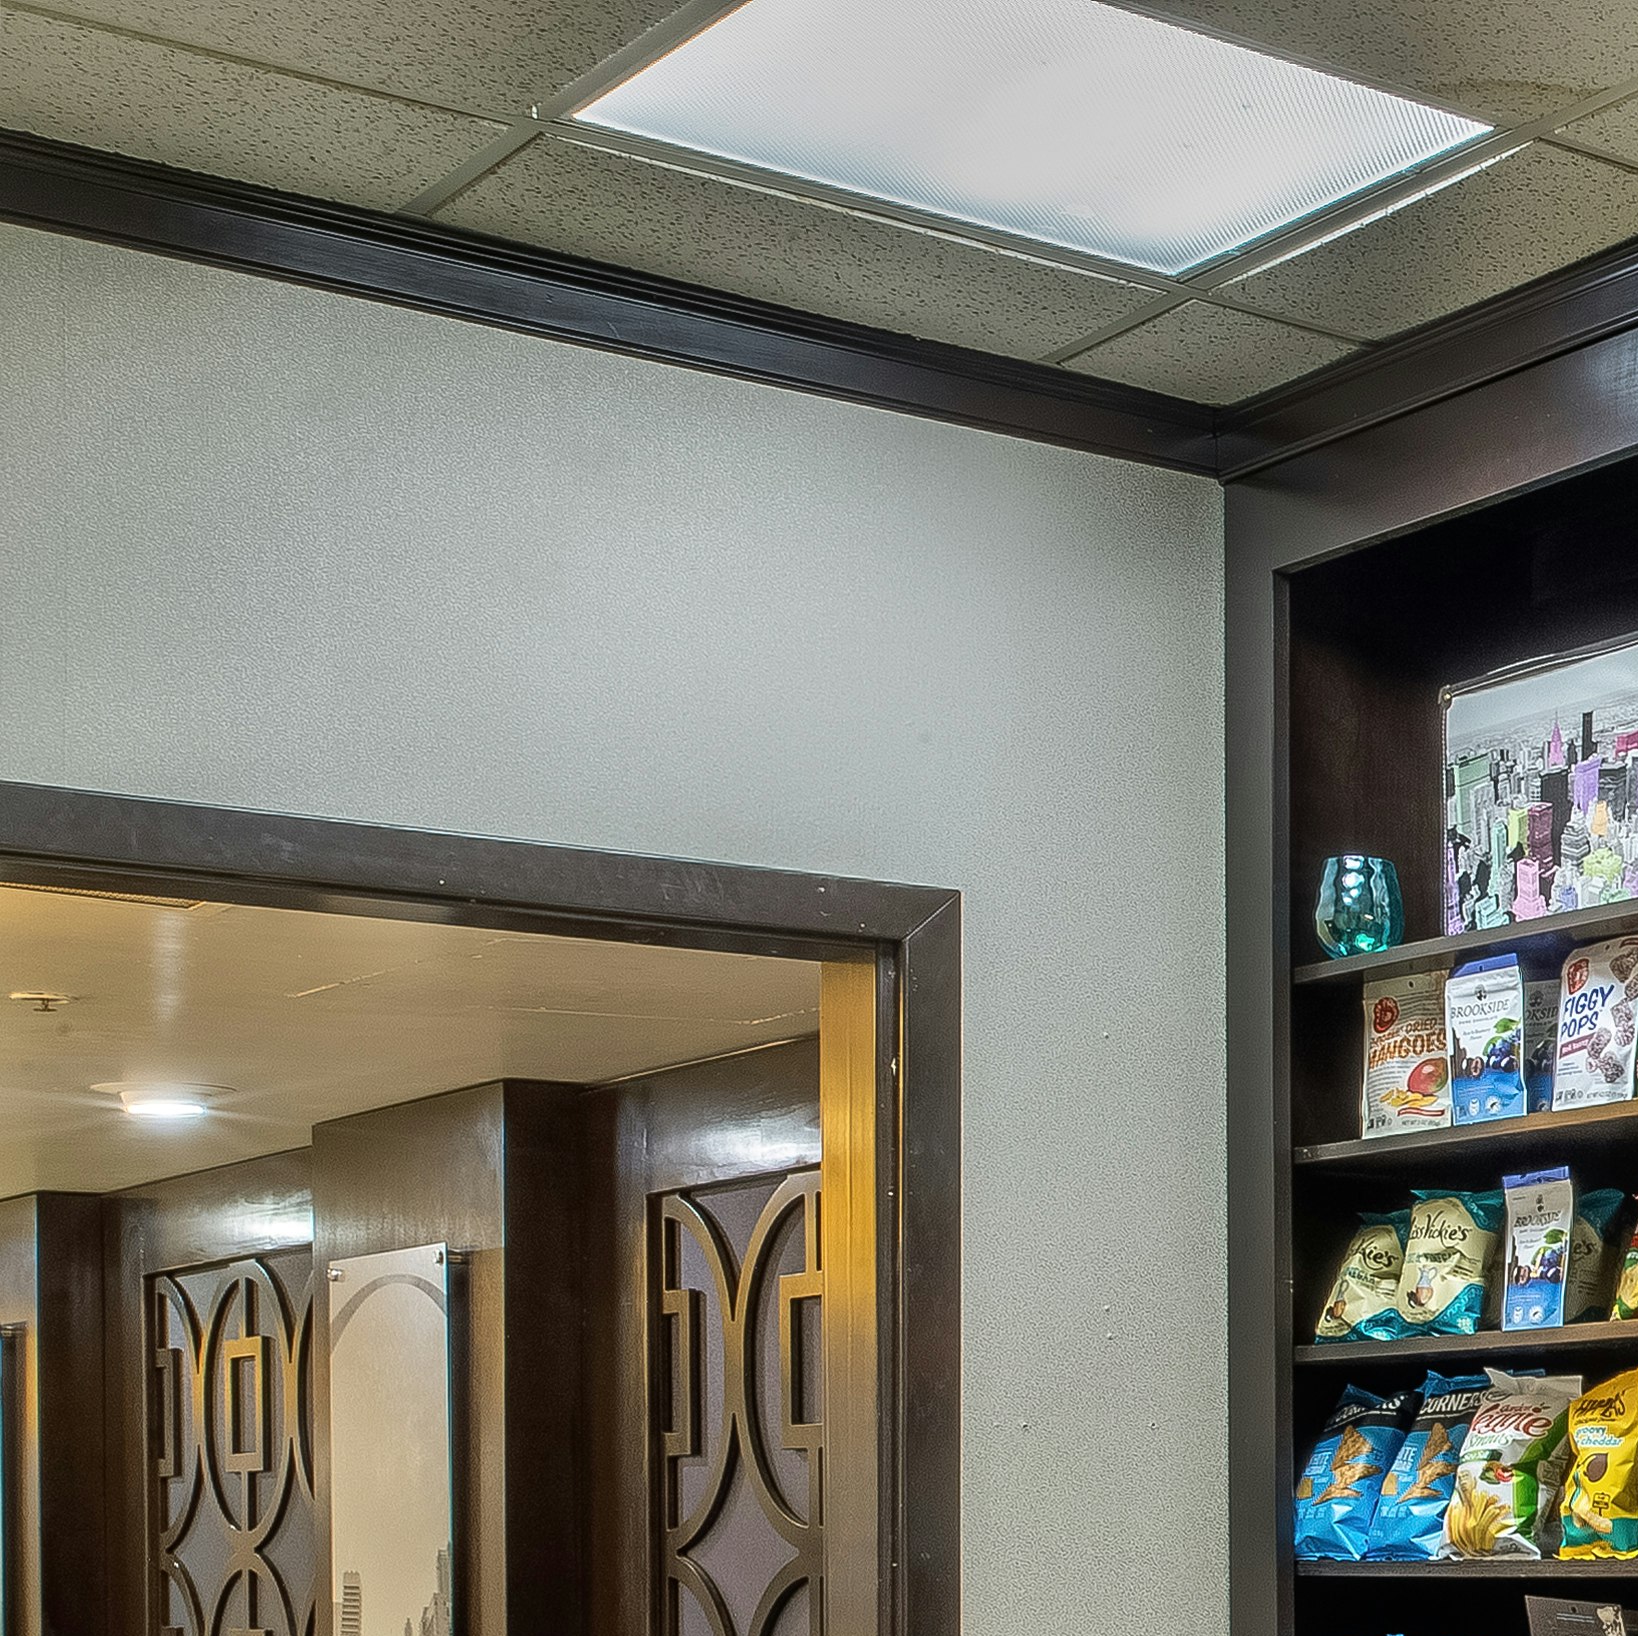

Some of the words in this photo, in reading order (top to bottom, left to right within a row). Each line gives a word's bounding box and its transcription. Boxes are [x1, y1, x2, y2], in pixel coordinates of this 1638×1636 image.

[1564, 984, 1615, 1017] FIGGY
[1560, 1012, 1598, 1041] POPS
[1581, 1436, 1623, 1448] cheddar
